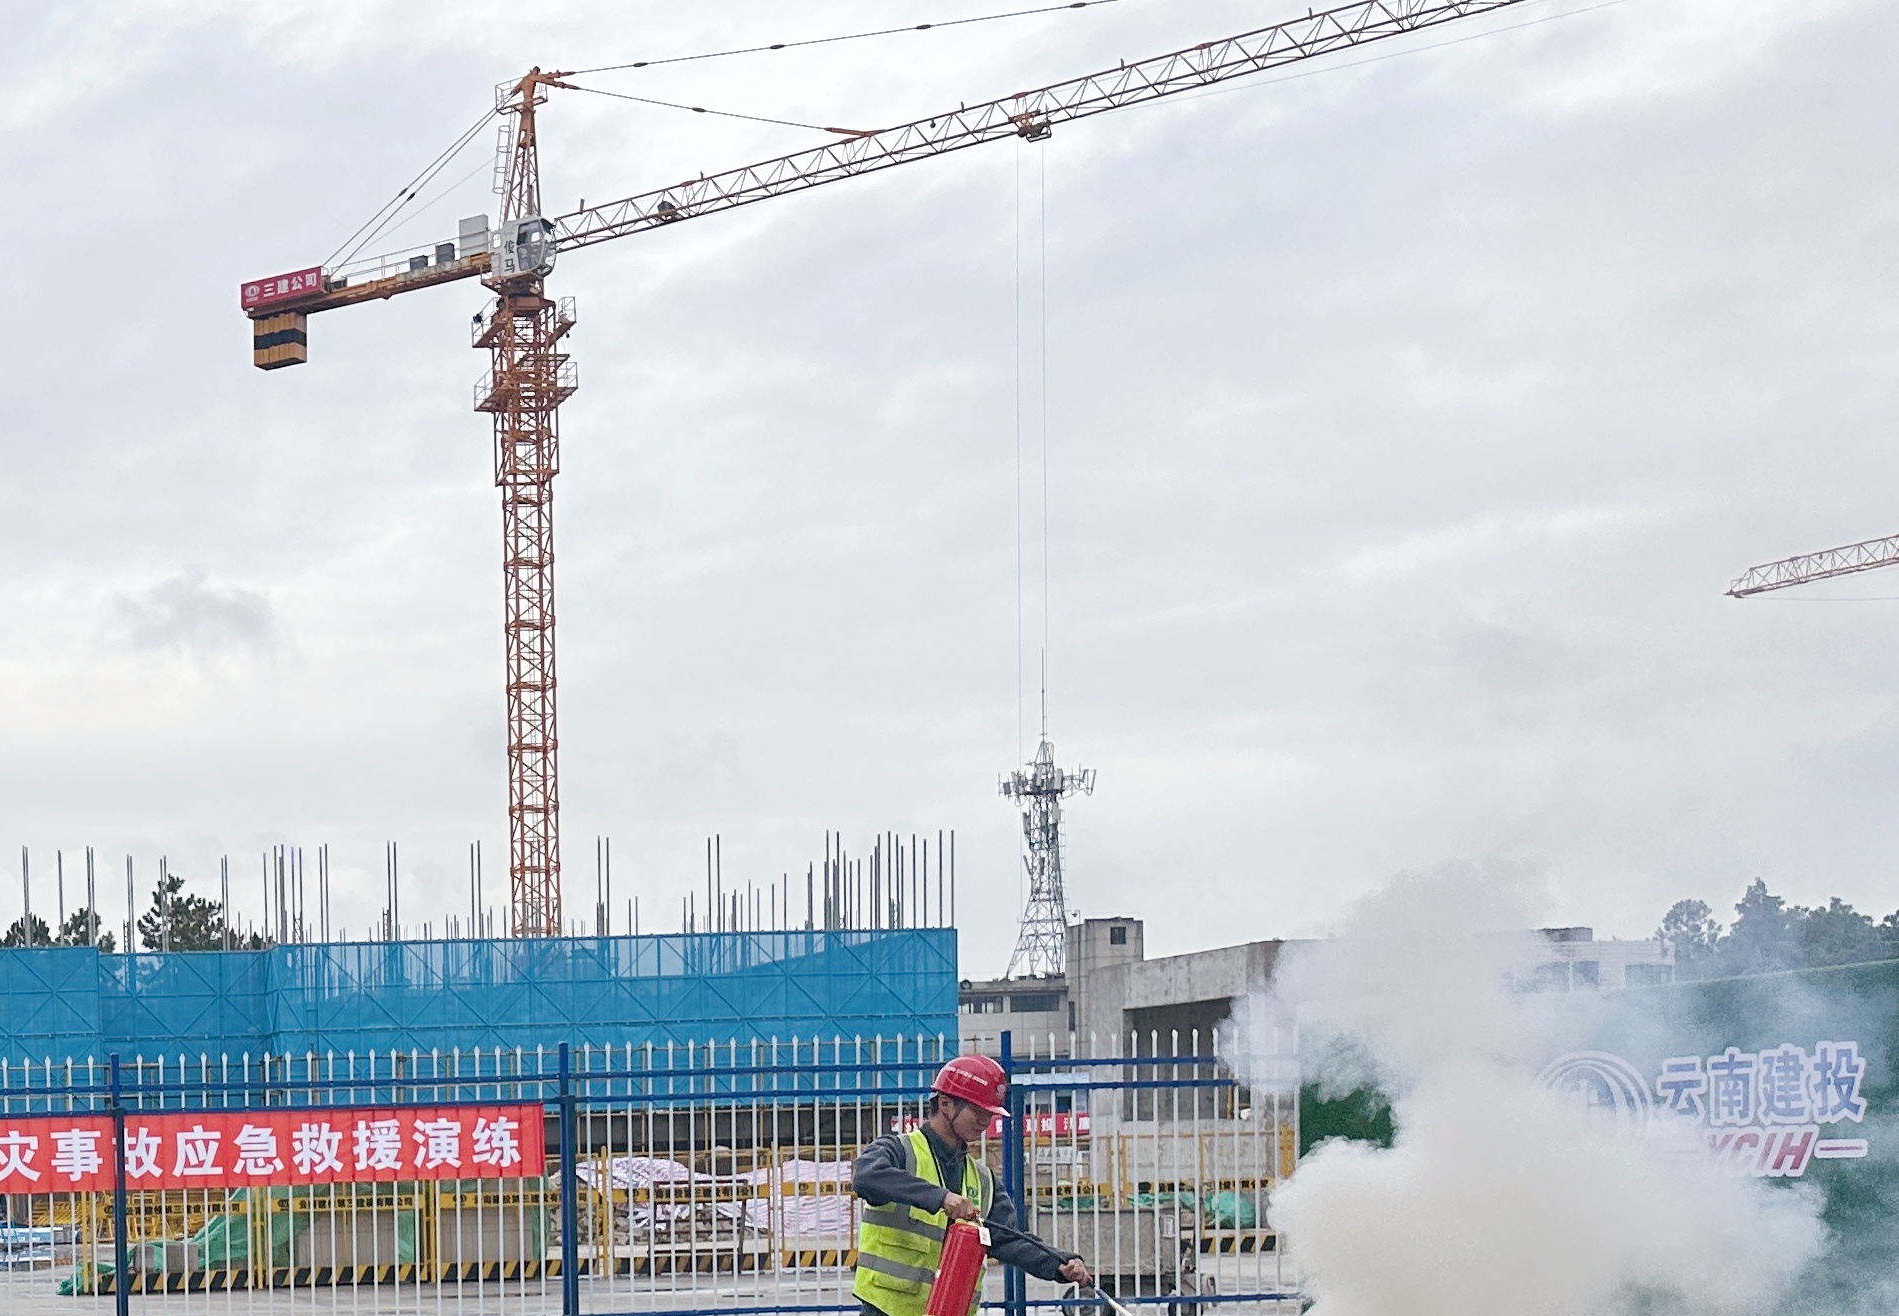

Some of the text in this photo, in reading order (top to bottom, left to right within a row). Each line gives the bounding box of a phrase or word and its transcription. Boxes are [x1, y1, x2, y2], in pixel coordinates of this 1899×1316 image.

[263, 272, 317, 298] 三建公司
[1660, 1046, 1861, 1118] 云南建投
